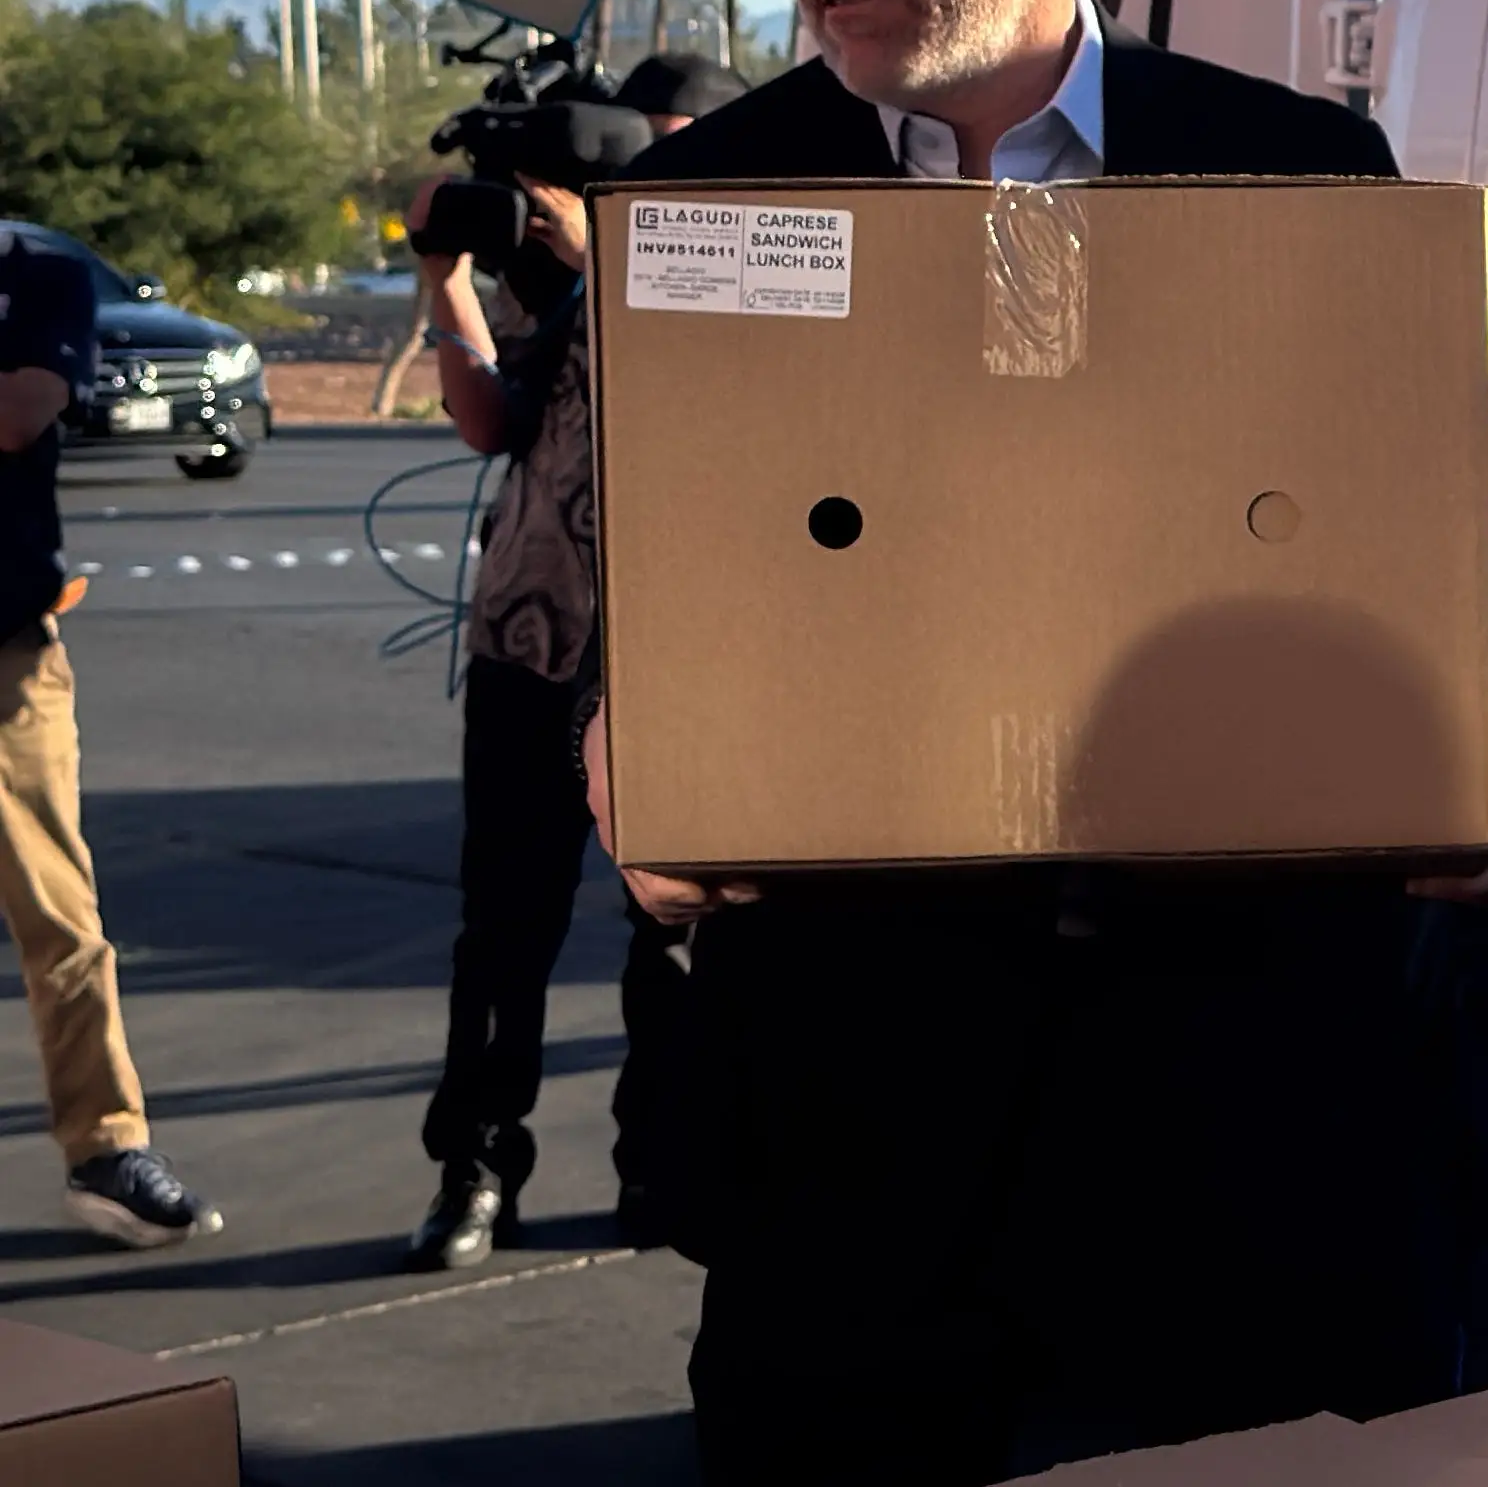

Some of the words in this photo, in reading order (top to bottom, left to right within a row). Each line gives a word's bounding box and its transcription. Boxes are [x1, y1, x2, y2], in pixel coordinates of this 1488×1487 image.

[663, 208, 739, 226] LAGUDI
[757, 214, 837, 230] CAPRESE
[751, 233, 842, 250] SANDWICH
[747, 253, 805, 268] LUNCH
[810, 255, 845, 270] BOX
